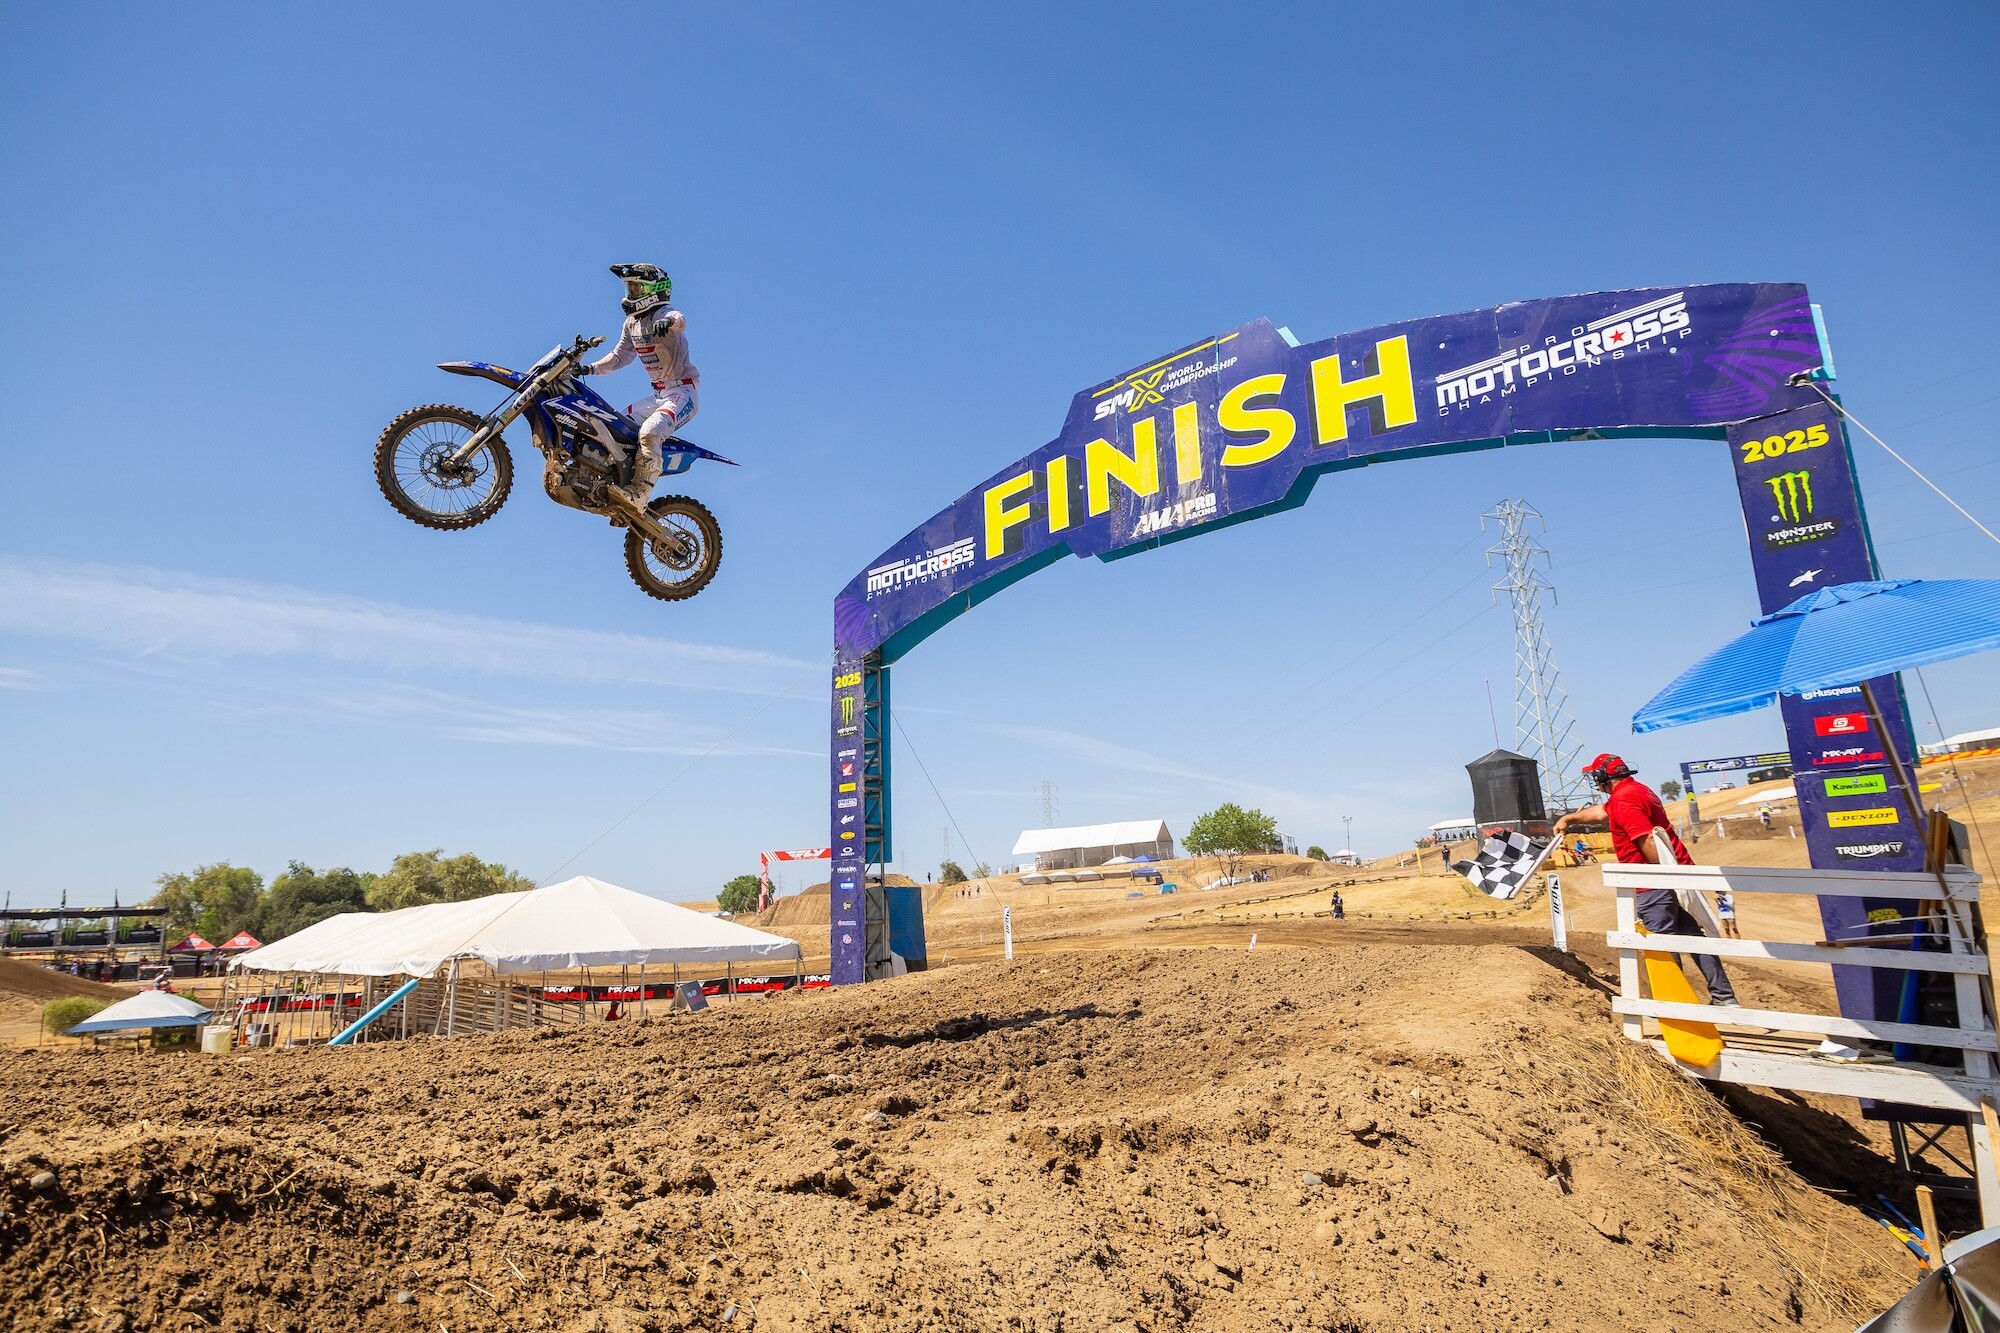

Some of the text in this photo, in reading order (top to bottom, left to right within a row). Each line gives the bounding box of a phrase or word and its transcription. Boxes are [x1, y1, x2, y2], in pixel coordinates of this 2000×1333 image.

[1519, 325, 1585, 355] PRO
[1436, 302, 1690, 408] MOTOCROSS
[1159, 356, 1238, 394] CHAMPIONSHIP
[1167, 360, 1204, 382] WORLD
[1439, 327, 1692, 417] CHAMPIONSHIP
[1093, 368, 1167, 421] SMX
[983, 334, 1418, 561] FINISH
[1740, 424, 1830, 463] 2025
[1184, 493, 1216, 514] PRO
[1185, 506, 1217, 521] RACING
[1131, 503, 1185, 538] AMA
[1768, 521, 1835, 541] MONSTER
[1778, 532, 1825, 545] ENERGY
[867, 543, 976, 593] MOTOCROSS
[904, 550, 933, 566] PRO
[867, 561, 975, 601] CHAMPIONSHIP
[834, 672, 862, 689] 2025
[1813, 685, 1861, 698] Husqvarn
[1822, 747, 1865, 758] MX-ATV
[1832, 779, 1879, 791] Kawasaki
[1841, 812, 1894, 822] DUNLOP
[1835, 843, 1891, 857] TRIUMPH
[1867, 908, 1898, 922] MOTO
